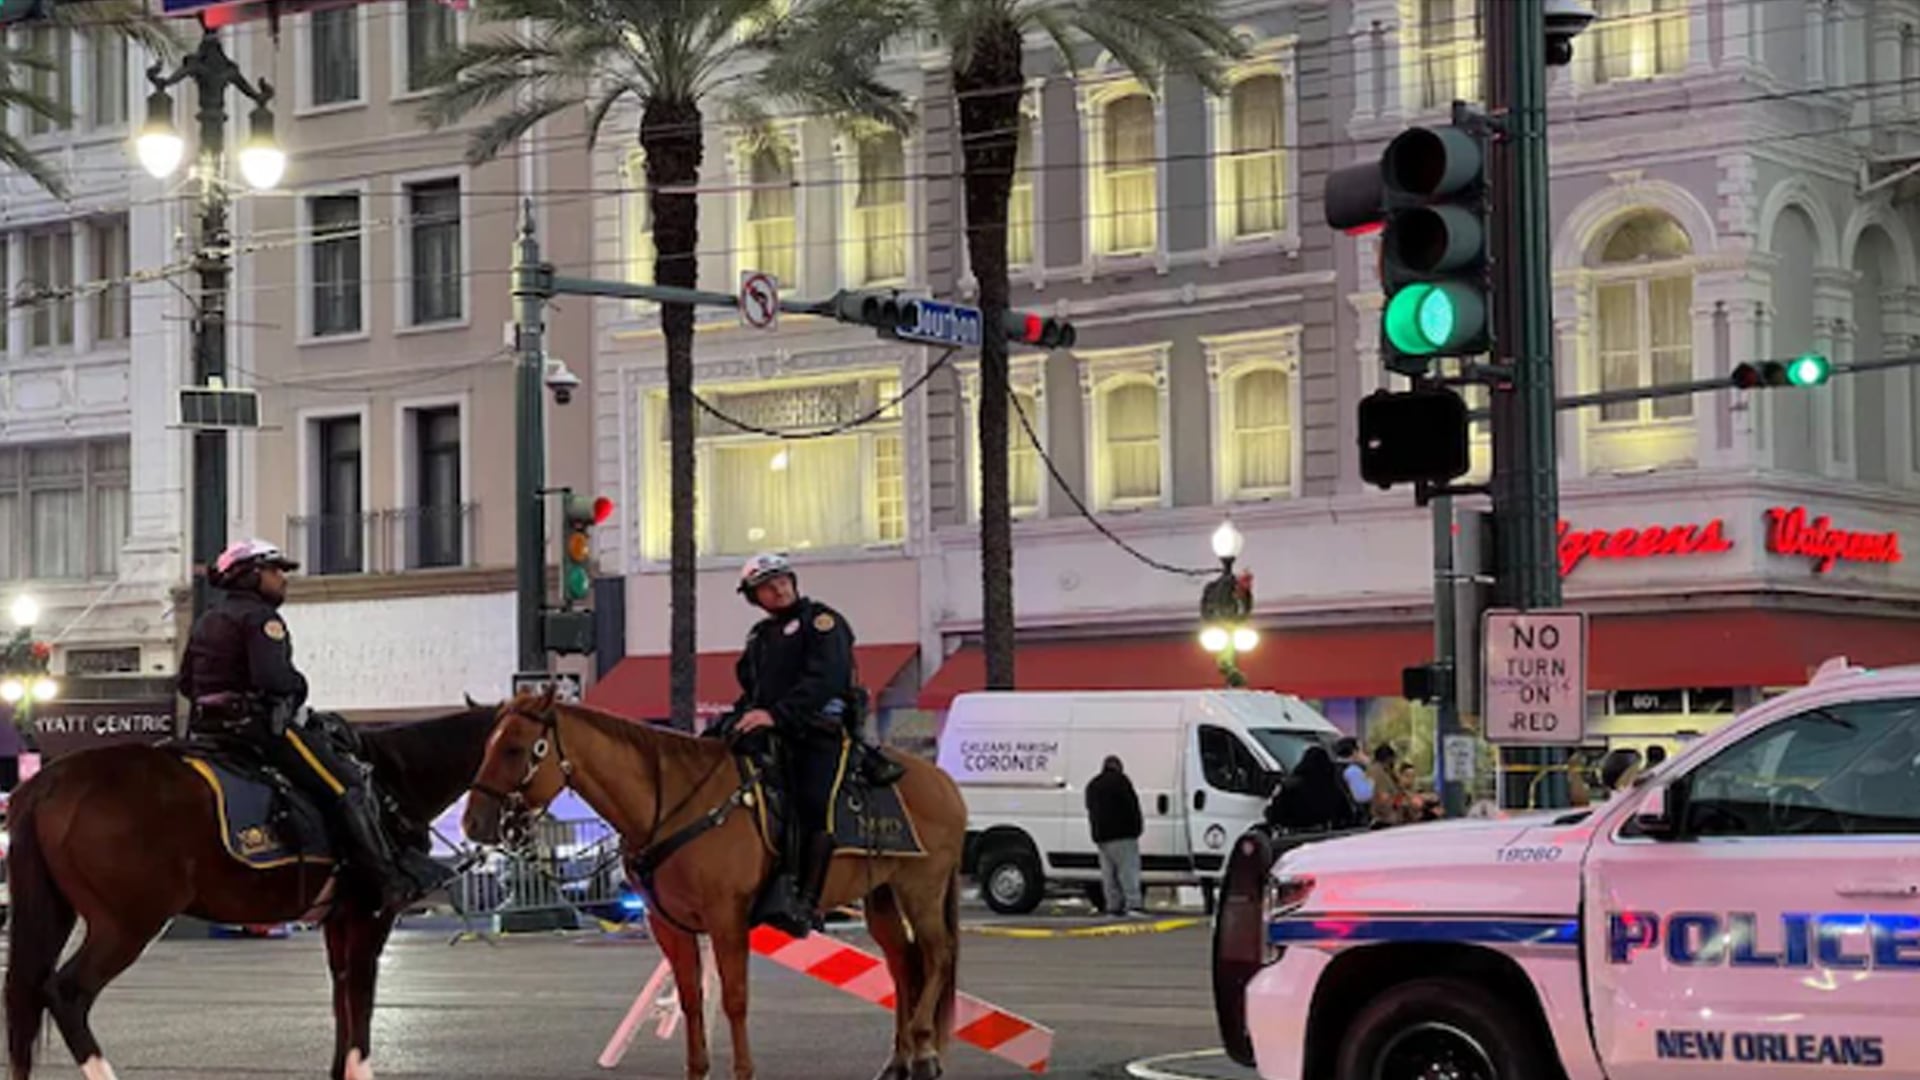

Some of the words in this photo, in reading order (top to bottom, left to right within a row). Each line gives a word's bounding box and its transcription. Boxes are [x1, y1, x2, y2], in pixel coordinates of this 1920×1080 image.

[1557, 517, 1733, 576] greens
[1766, 506, 1903, 573] Walgreens
[1511, 623, 1560, 651] NO
[1507, 658, 1565, 677] TURN
[1521, 684, 1551, 704] ON
[92, 713, 173, 735] CENTRIC
[1511, 711, 1559, 732] RED
[963, 754, 1050, 772] CORONER
[1605, 911, 1920, 970] POLICE
[1655, 1029, 1726, 1061] NEW
[1733, 1032, 1884, 1067] ORLEANS
